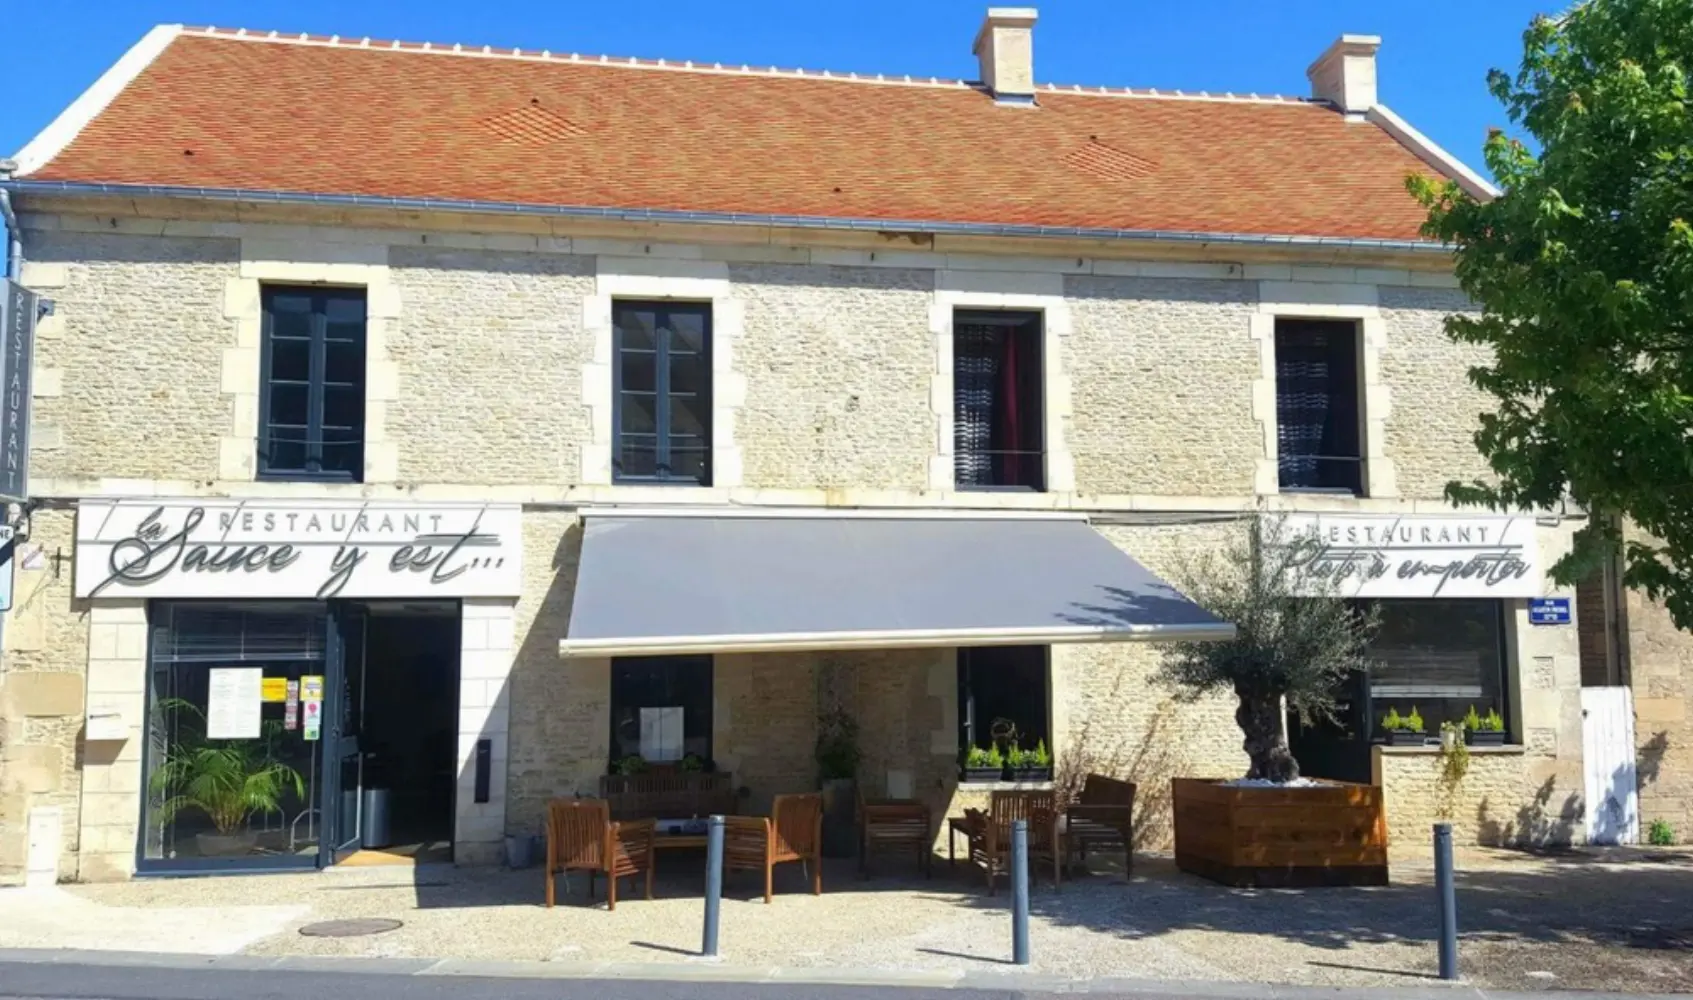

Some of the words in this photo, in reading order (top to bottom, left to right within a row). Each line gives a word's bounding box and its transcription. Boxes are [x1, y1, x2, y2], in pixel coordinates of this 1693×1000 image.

[8, 292, 24, 489] RESTAURANT
[136, 505, 168, 540] la
[219, 512, 443, 532] RESTAURANT
[88, 507, 300, 599] Sauce
[316, 545, 369, 599] y
